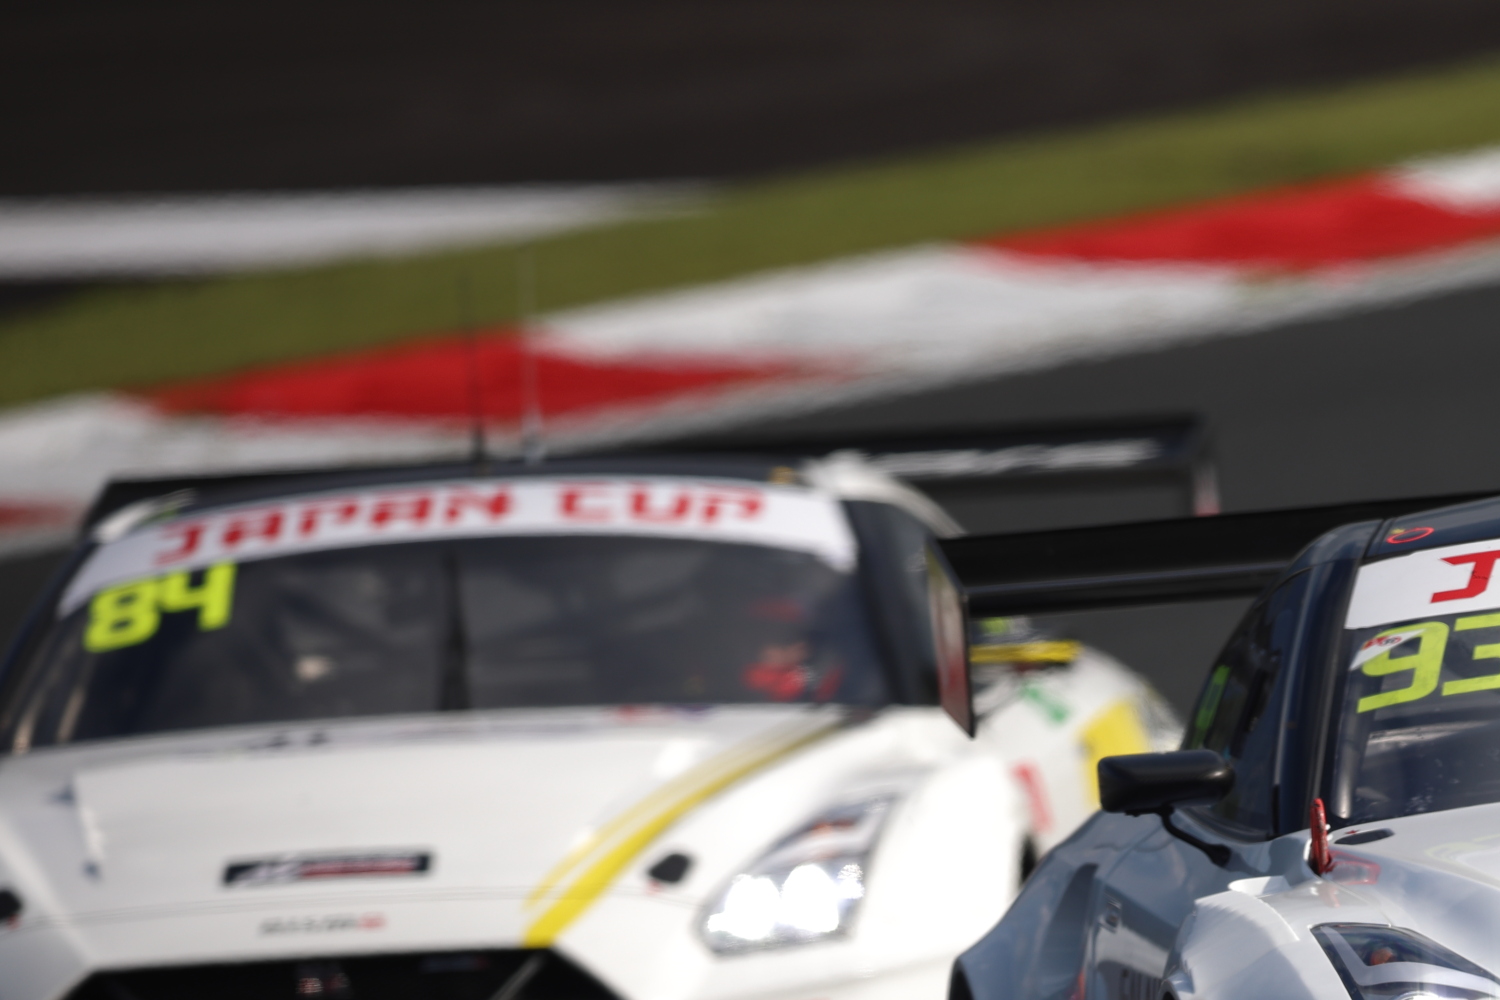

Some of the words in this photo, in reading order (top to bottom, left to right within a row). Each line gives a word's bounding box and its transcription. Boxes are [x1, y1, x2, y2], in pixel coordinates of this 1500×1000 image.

[152, 487, 512, 566] JAPAN
[556, 483, 768, 526] CUP
[84, 559, 237, 653] 84
